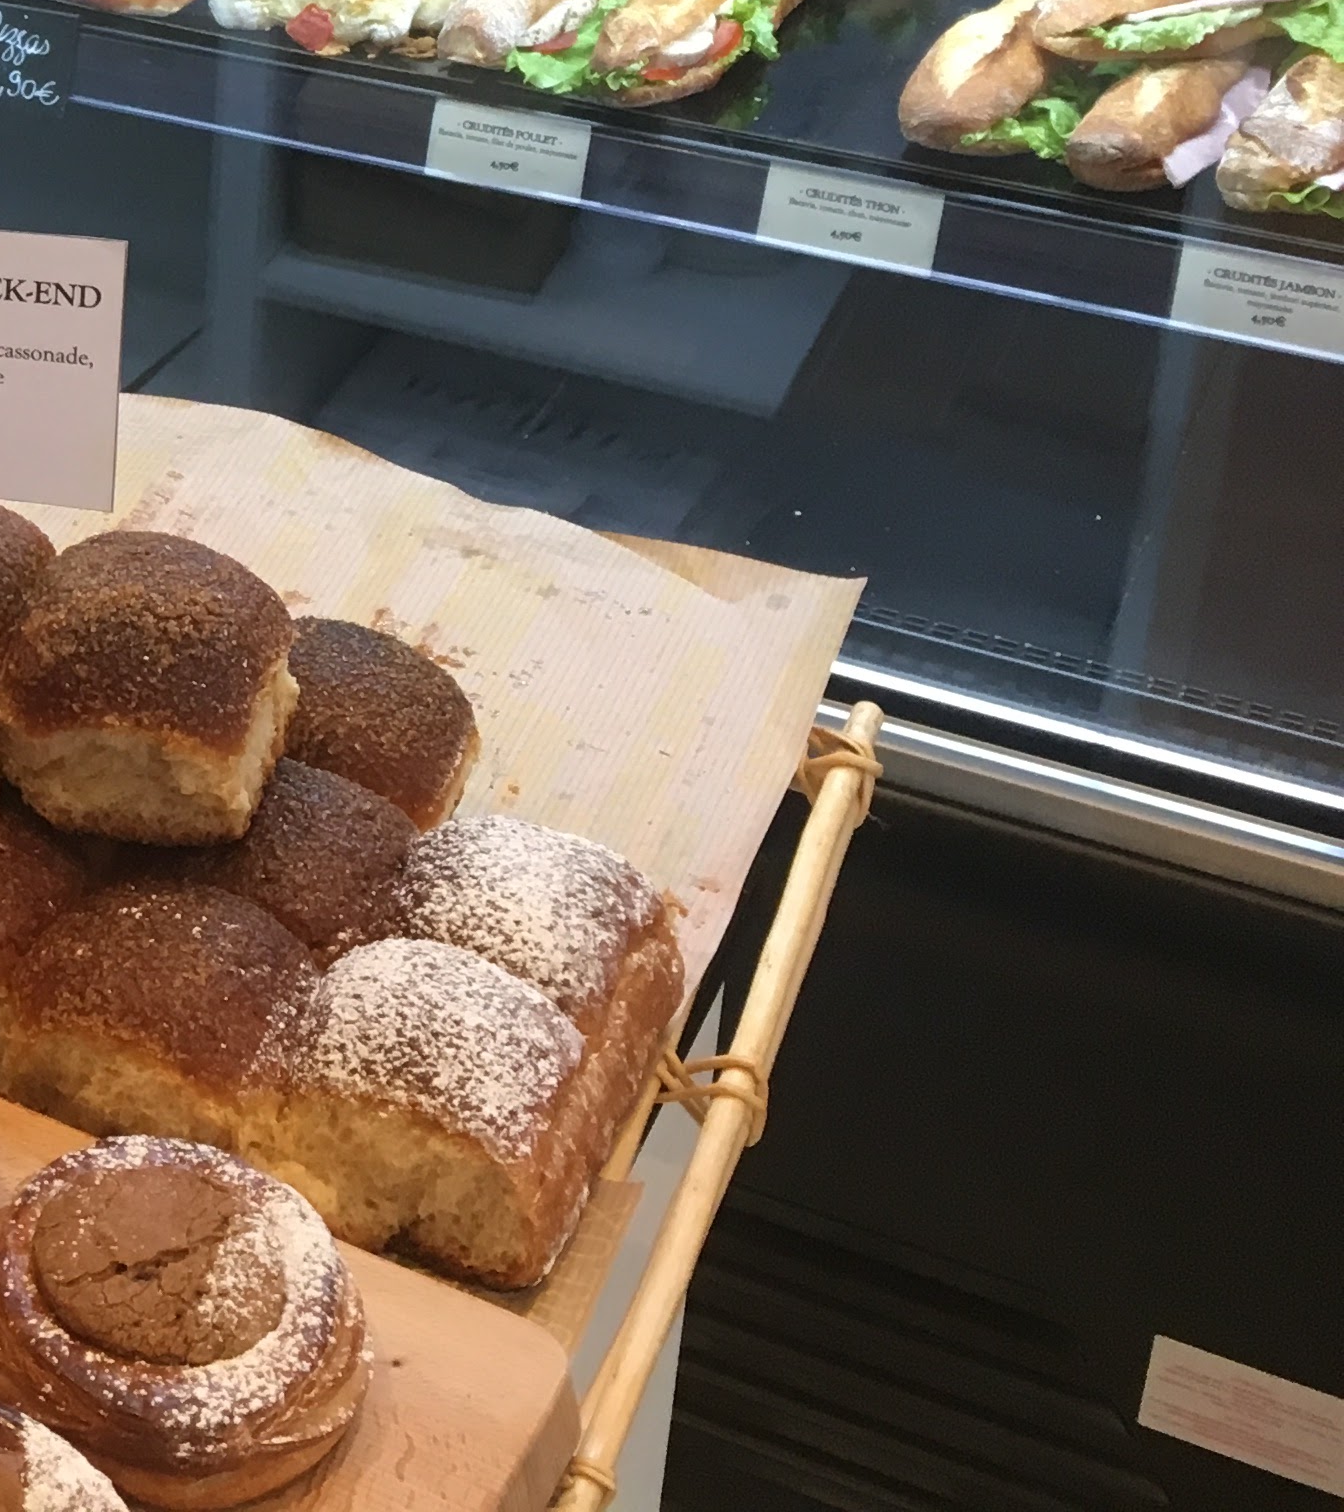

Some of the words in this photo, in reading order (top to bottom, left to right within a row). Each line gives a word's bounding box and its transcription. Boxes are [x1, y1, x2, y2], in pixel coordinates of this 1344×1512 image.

[516, 130, 557, 145] POULET
[865, 199, 900, 215] THON
[1278, 281, 1336, 299] JAMBON
